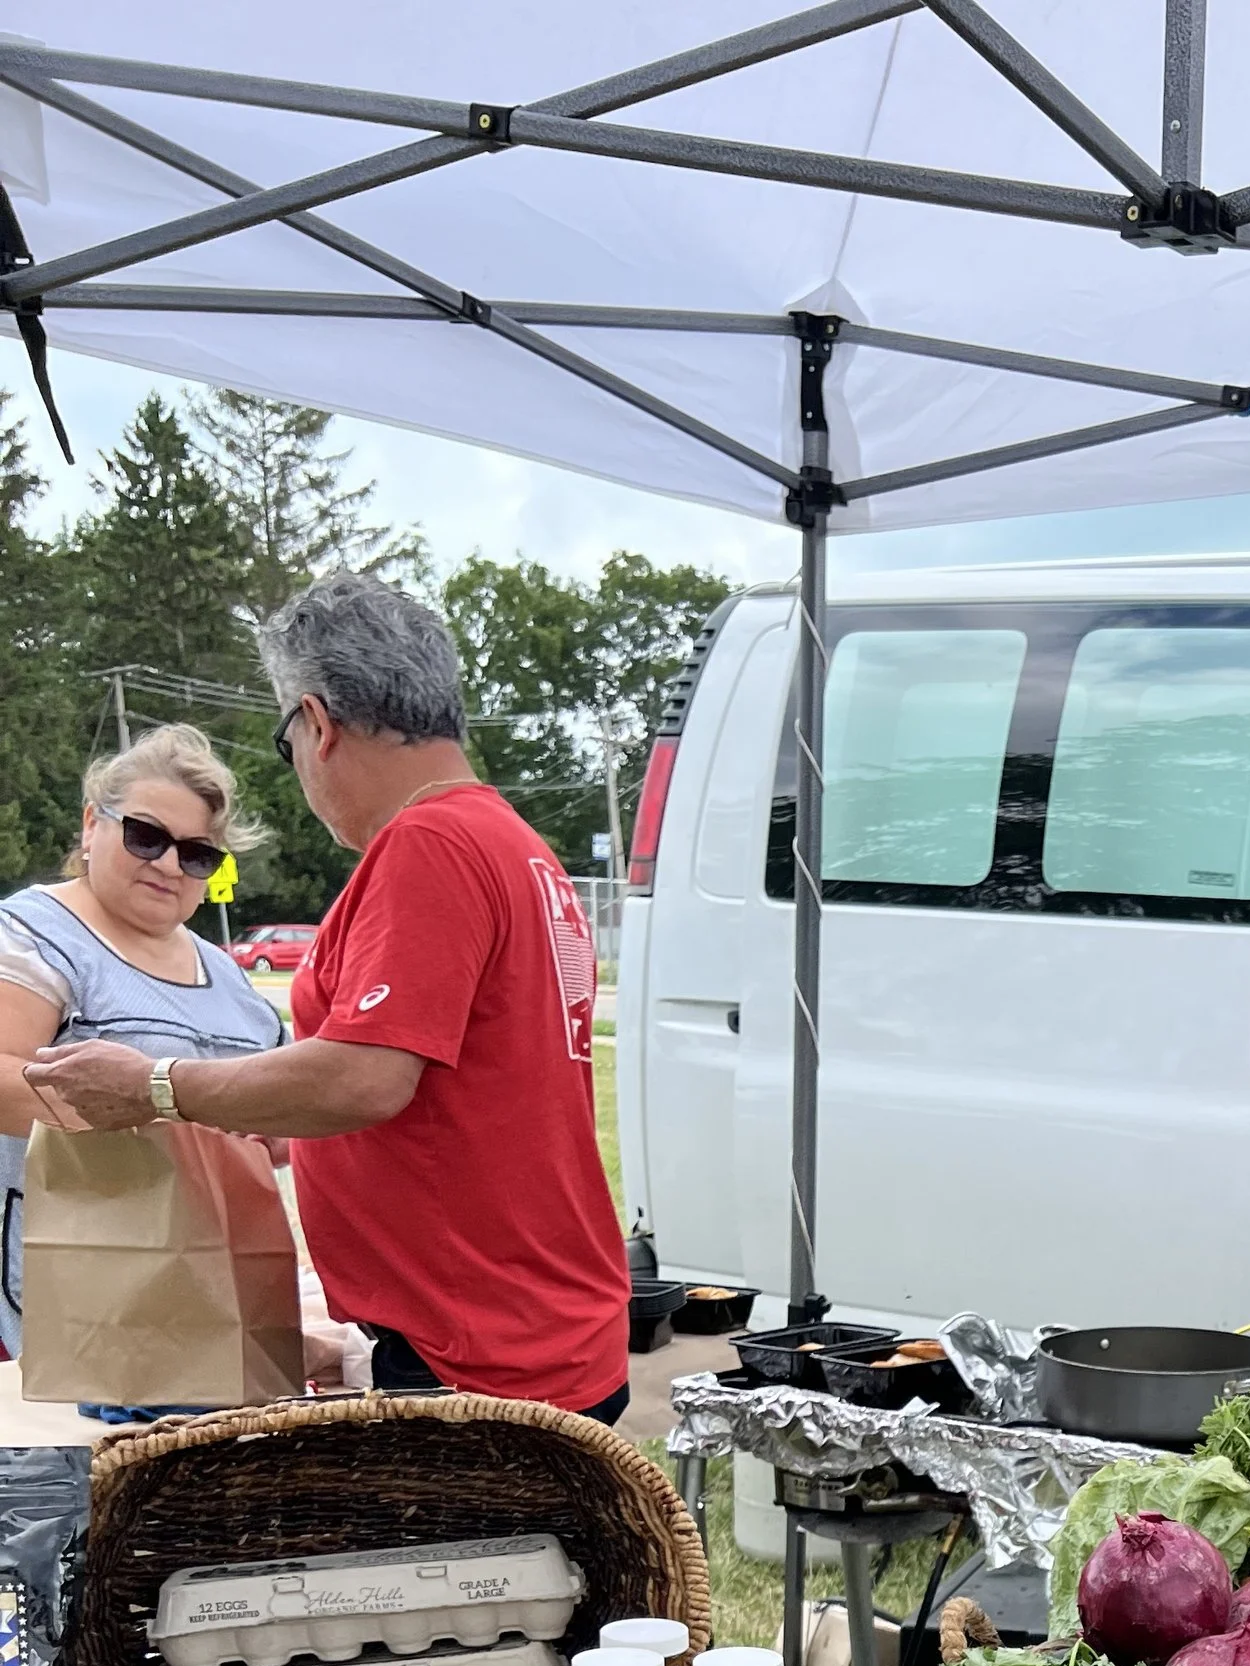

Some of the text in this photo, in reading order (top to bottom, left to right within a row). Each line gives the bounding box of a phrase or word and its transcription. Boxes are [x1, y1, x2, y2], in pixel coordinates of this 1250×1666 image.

[459, 1577, 511, 1591] GRADE A
[467, 1587, 506, 1600] LARGE
[199, 1600, 249, 1613] 12 EGGS
